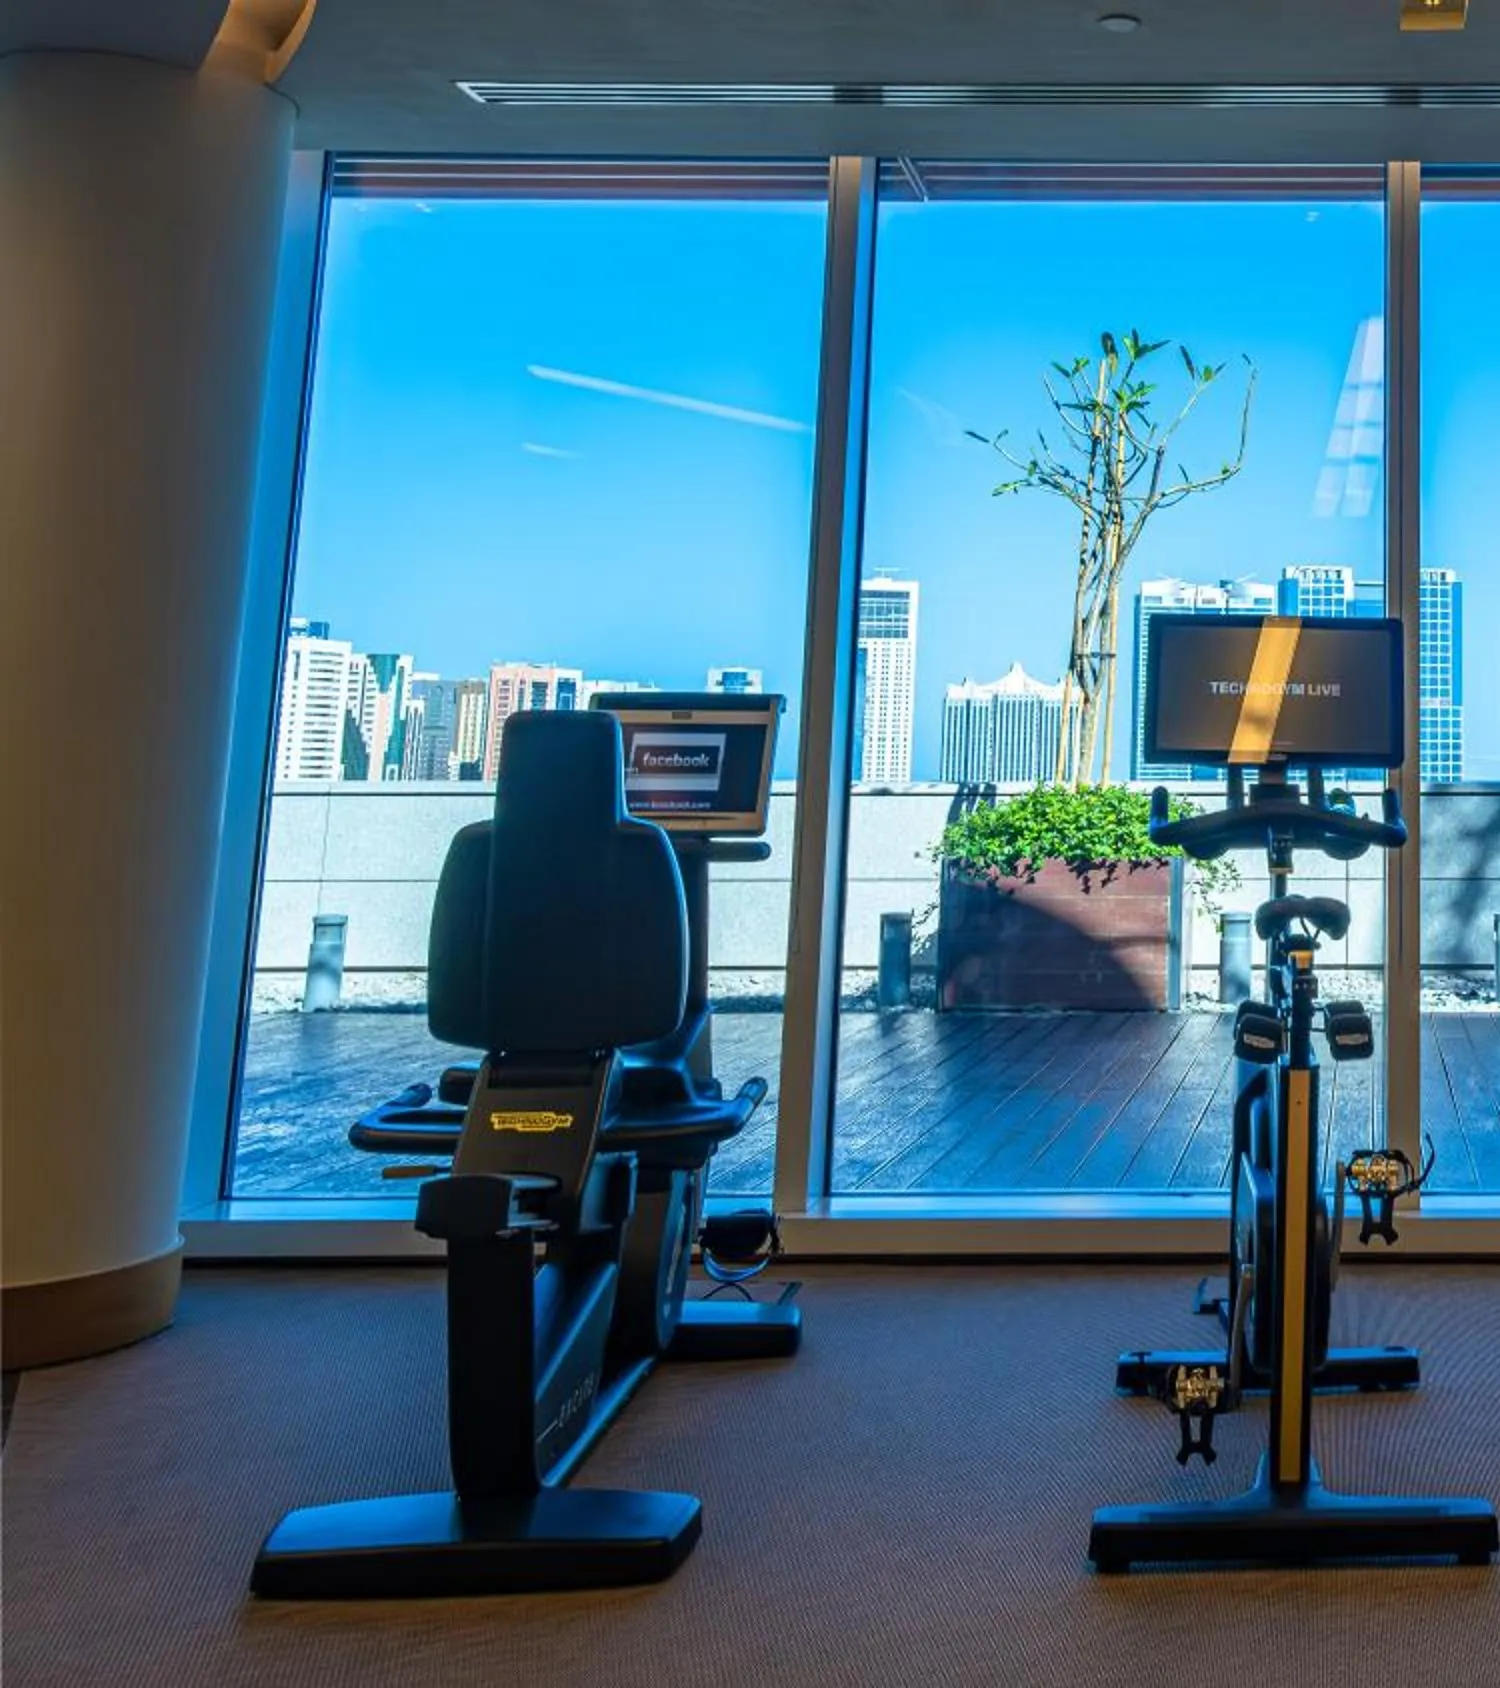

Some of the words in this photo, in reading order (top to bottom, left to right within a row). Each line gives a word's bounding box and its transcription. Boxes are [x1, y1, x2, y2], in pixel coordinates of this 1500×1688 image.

[1209, 681, 1304, 695] TECHNOGYM
[1307, 683, 1341, 697] LIVE
[642, 751, 710, 767] facebook
